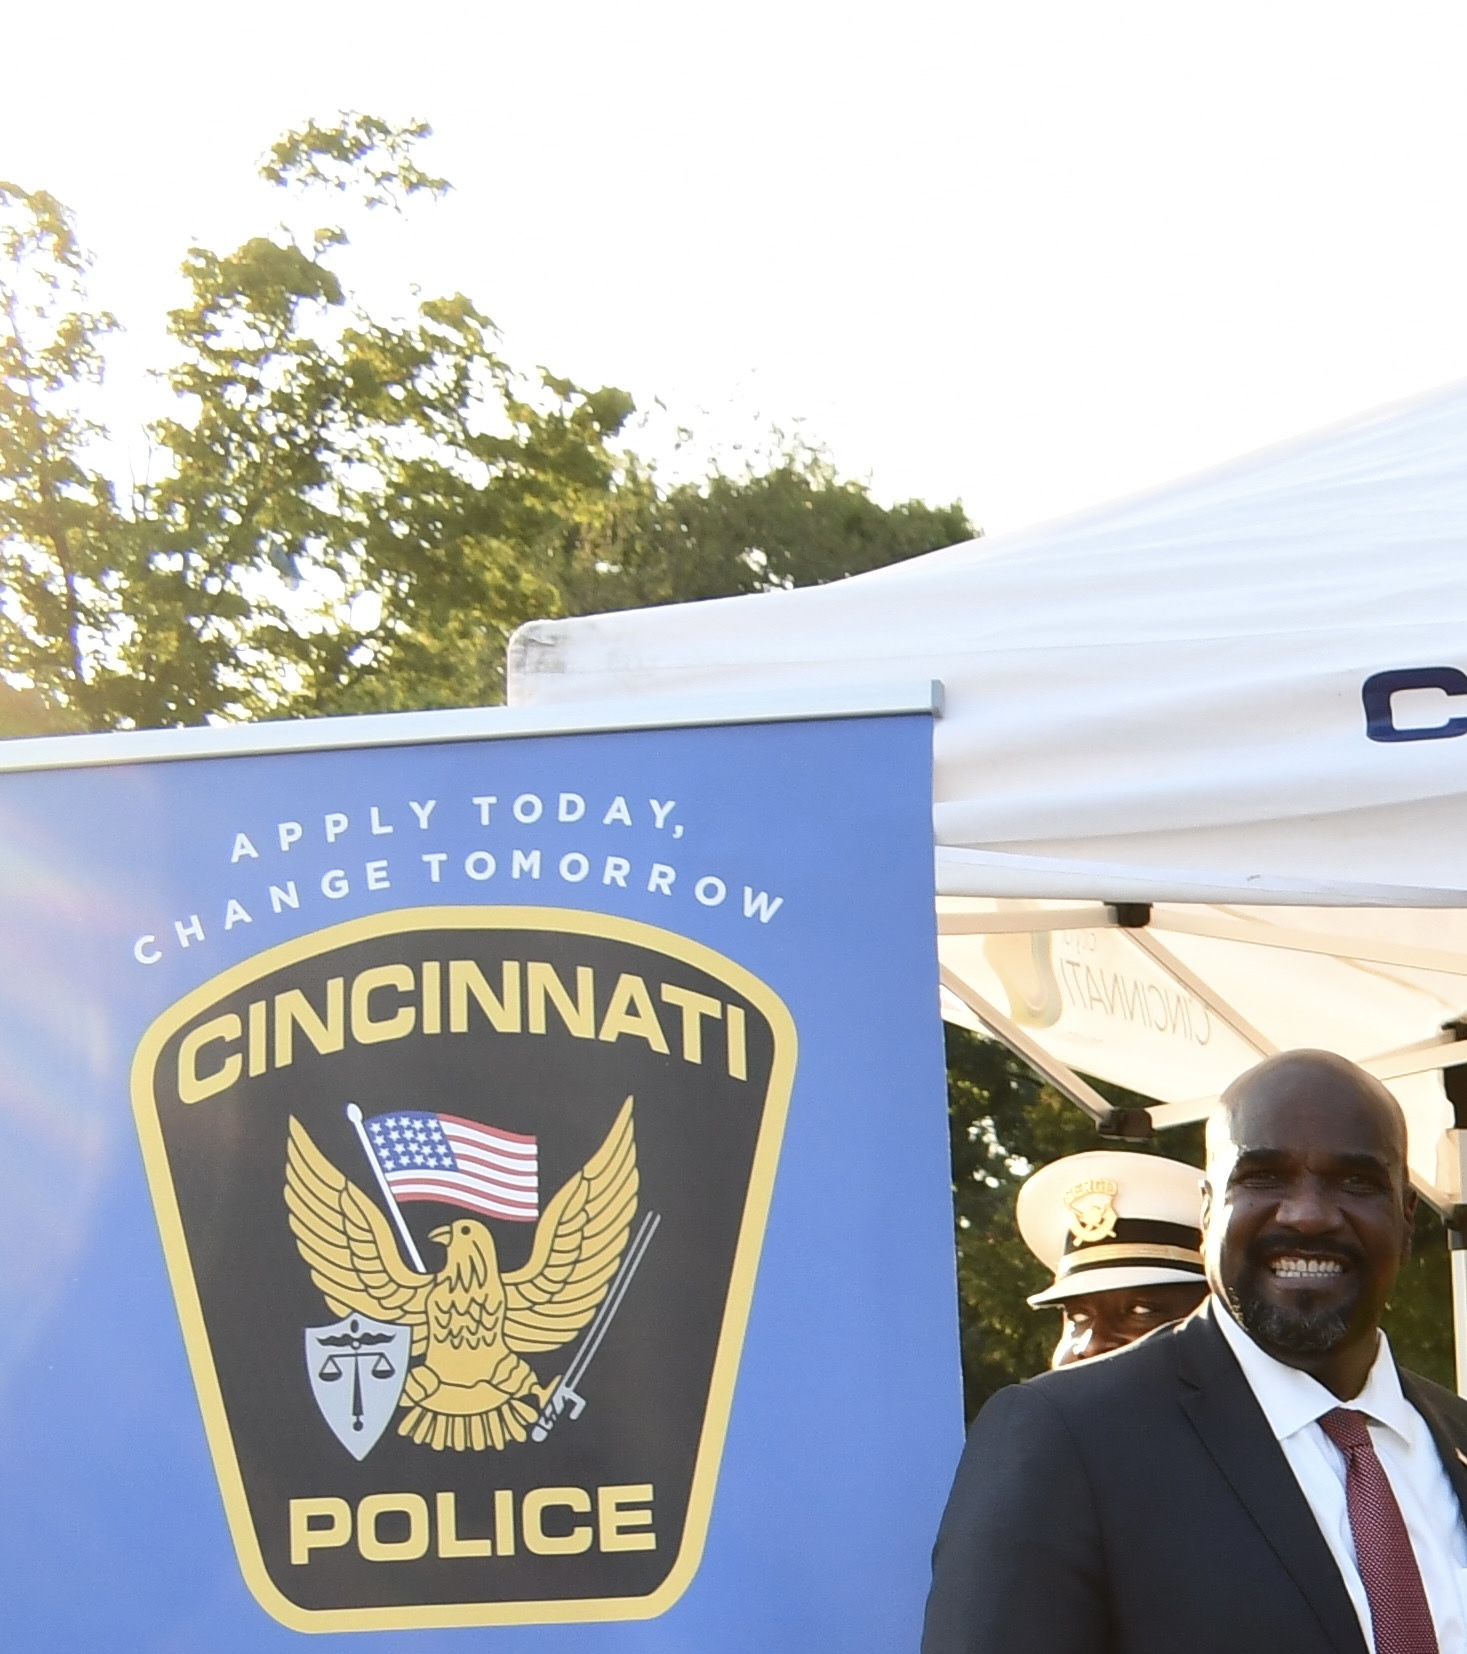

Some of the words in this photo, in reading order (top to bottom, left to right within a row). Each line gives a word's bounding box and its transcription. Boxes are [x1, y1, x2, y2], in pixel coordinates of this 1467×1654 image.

[230, 800, 437, 862] APPLY
[473, 793, 685, 839] TODAY,
[133, 859, 390, 965] CHANGE
[423, 850, 784, 924] TOMORROW
[177, 959, 750, 1105] CINCINNATI
[288, 1484, 658, 1565] POLICE
